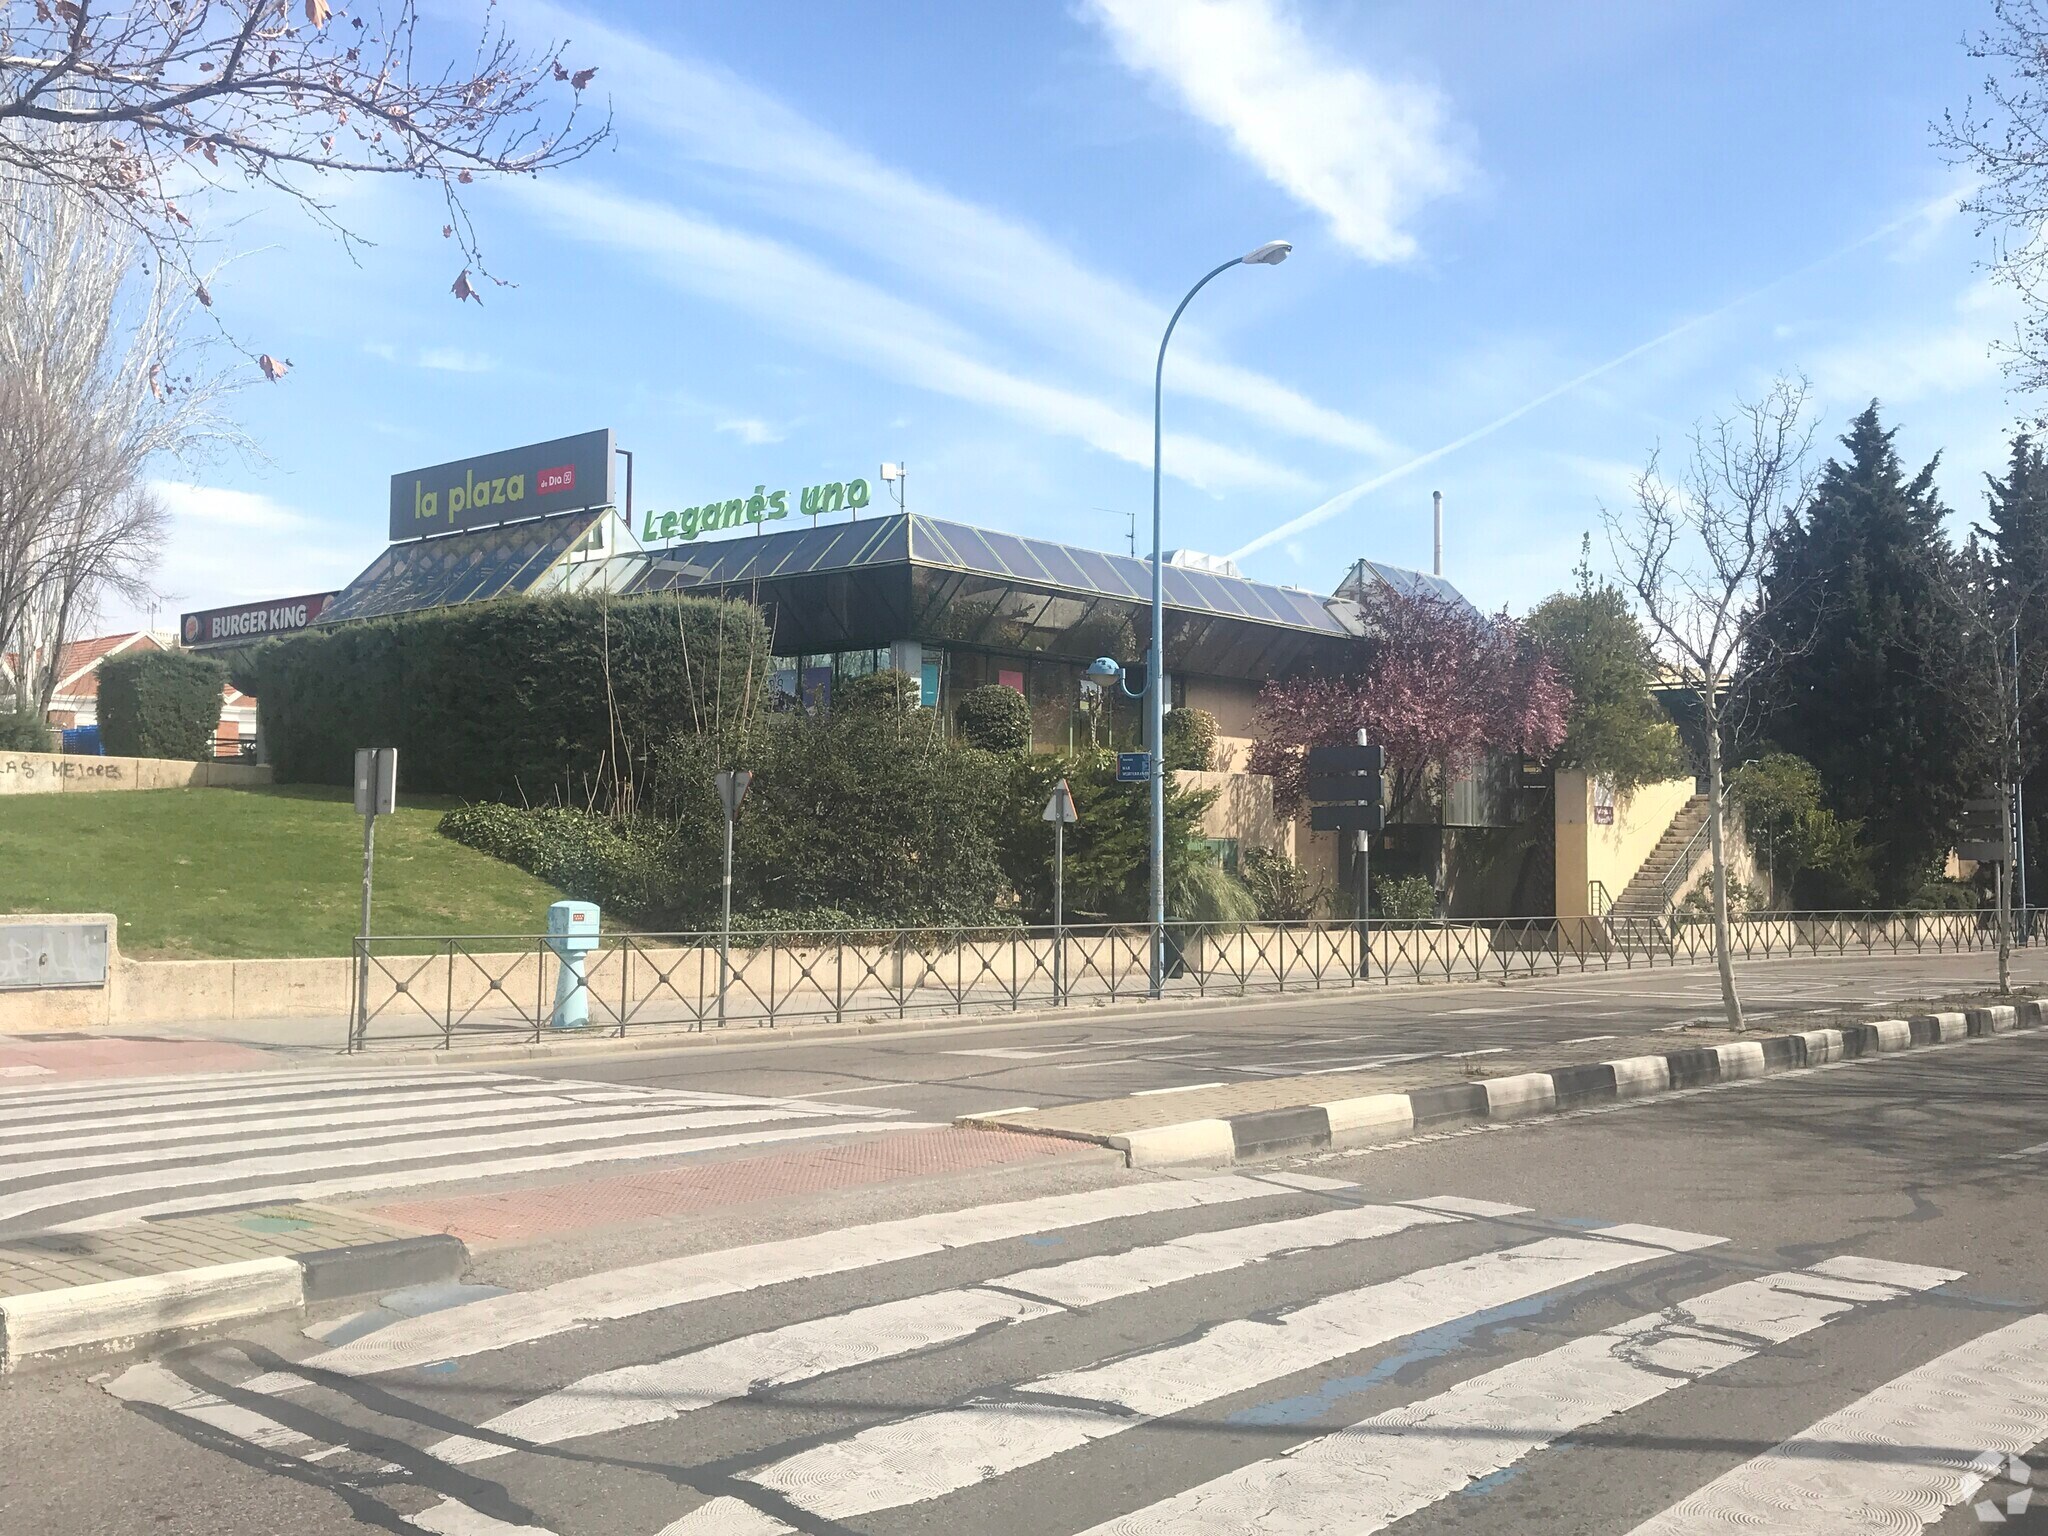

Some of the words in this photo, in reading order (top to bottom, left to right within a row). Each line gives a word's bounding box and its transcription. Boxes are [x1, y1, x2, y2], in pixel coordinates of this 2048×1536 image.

[415, 480, 438, 518] la
[449, 470, 525, 523] plaza
[642, 485, 789, 542] Leganés
[800, 478, 870, 515] uno
[212, 611, 267, 638] BURGER
[269, 604, 307, 630] KING
